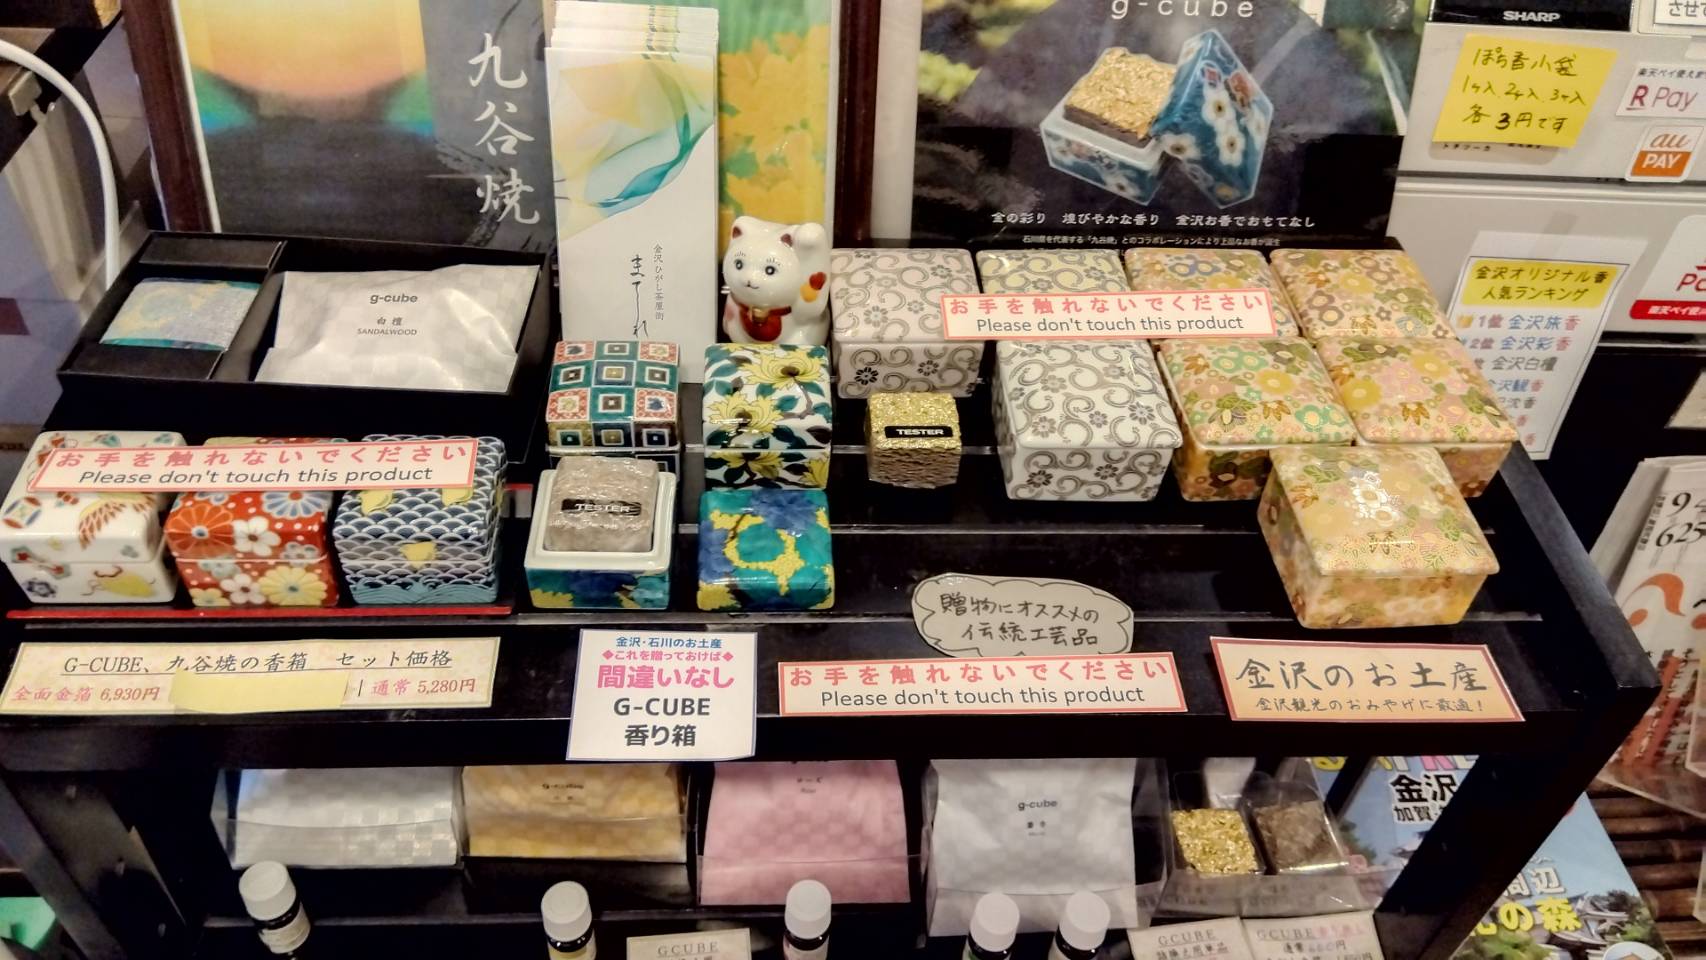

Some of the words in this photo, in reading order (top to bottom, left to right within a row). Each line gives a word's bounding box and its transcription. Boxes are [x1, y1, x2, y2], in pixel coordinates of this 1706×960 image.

[1502, 10, 1561, 22] SHARP
[1651, 86, 1699, 112] Pay
[468, 32, 541, 225] 九谷焼
[1650, 133, 1691, 149] au
[1642, 153, 1682, 169] PAY
[1474, 265, 1608, 284] 金沢オリジナル香
[369, 293, 419, 305] g-cube
[1481, 285, 1589, 302] 人気ランキング
[949, 294, 1264, 315] お手を触れないでください
[357, 327, 418, 336] SANDALWOOD
[976, 318, 1032, 332] Please
[1037, 317, 1082, 332] don't
[1086, 317, 1135, 332] touch
[1140, 316, 1175, 331] this
[1177, 316, 1244, 333] product
[895, 428, 945, 436] TESTER
[55, 445, 466, 467] お手を触れないでください
[79, 470, 151, 484] Please
[158, 470, 219, 484] don't
[226, 469, 290, 483] touch
[298, 468, 338, 482] this
[344, 467, 433, 485] product
[574, 502, 631, 513] TESTER
[615, 636, 722, 649] 金沢・石川のお土産
[961, 622, 1099, 646] 伝統工芸品
[335, 649, 453, 668] セット価格
[597, 664, 735, 689] 間違いなし
[789, 660, 1168, 687] お手を触れないでください
[1235, 658, 1488, 692] 金沢のお土産
[100, 686, 161, 702] 6,930円
[417, 677, 476, 695] 5,280円
[821, 690, 888, 706] Please
[894, 688, 950, 705] don't
[956, 687, 1014, 704] touch
[1019, 687, 1058, 703] this
[1064, 686, 1146, 706] product
[613, 697, 711, 716] G-CUBE
[624, 723, 697, 747] 香り箱
[1389, 773, 1458, 803] 金沢
[1017, 799, 1058, 811] g-cube
